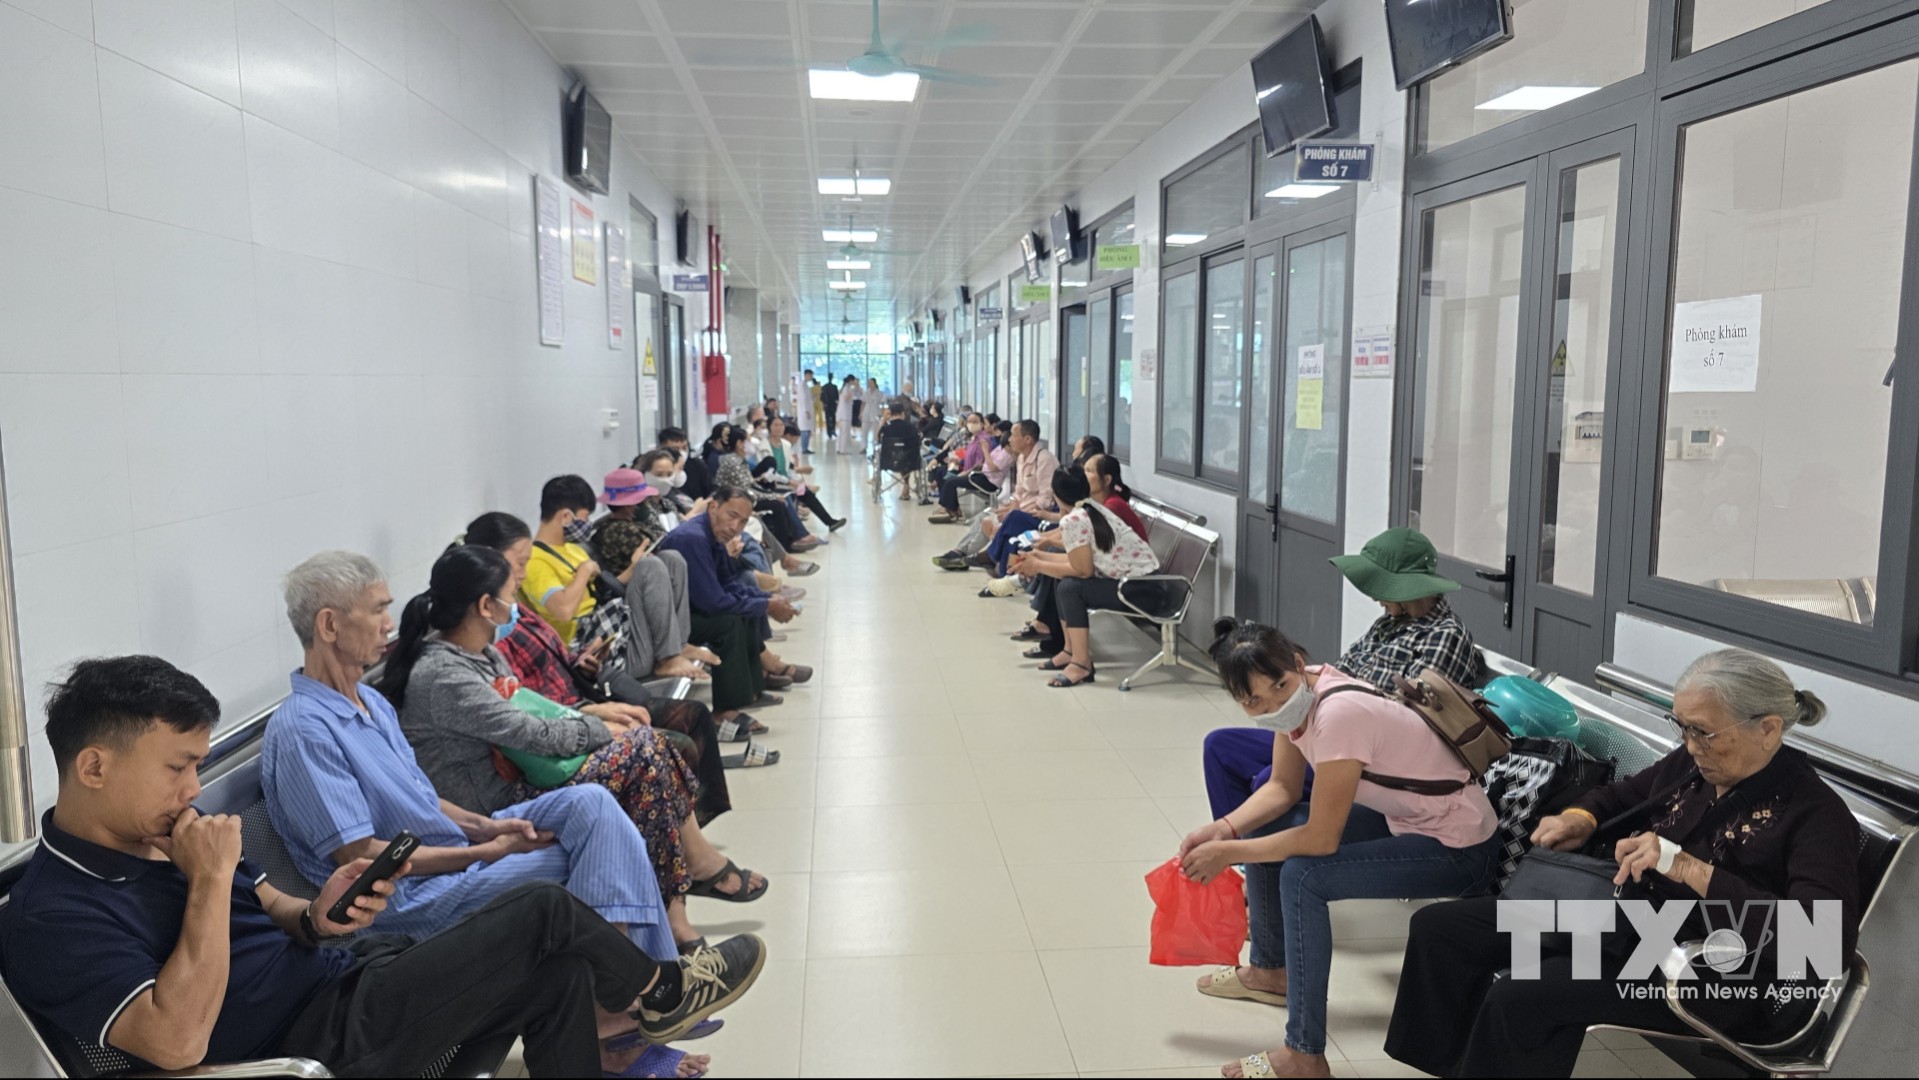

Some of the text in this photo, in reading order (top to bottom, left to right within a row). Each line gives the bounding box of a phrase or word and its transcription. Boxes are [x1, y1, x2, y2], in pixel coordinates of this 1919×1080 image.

[1304, 146, 1367, 160] PHÒNG KHÁM
[1321, 161, 1348, 177] SỐ 7
[1685, 323, 1748, 343] Phòng khám
[1703, 348, 1724, 367] số 7
